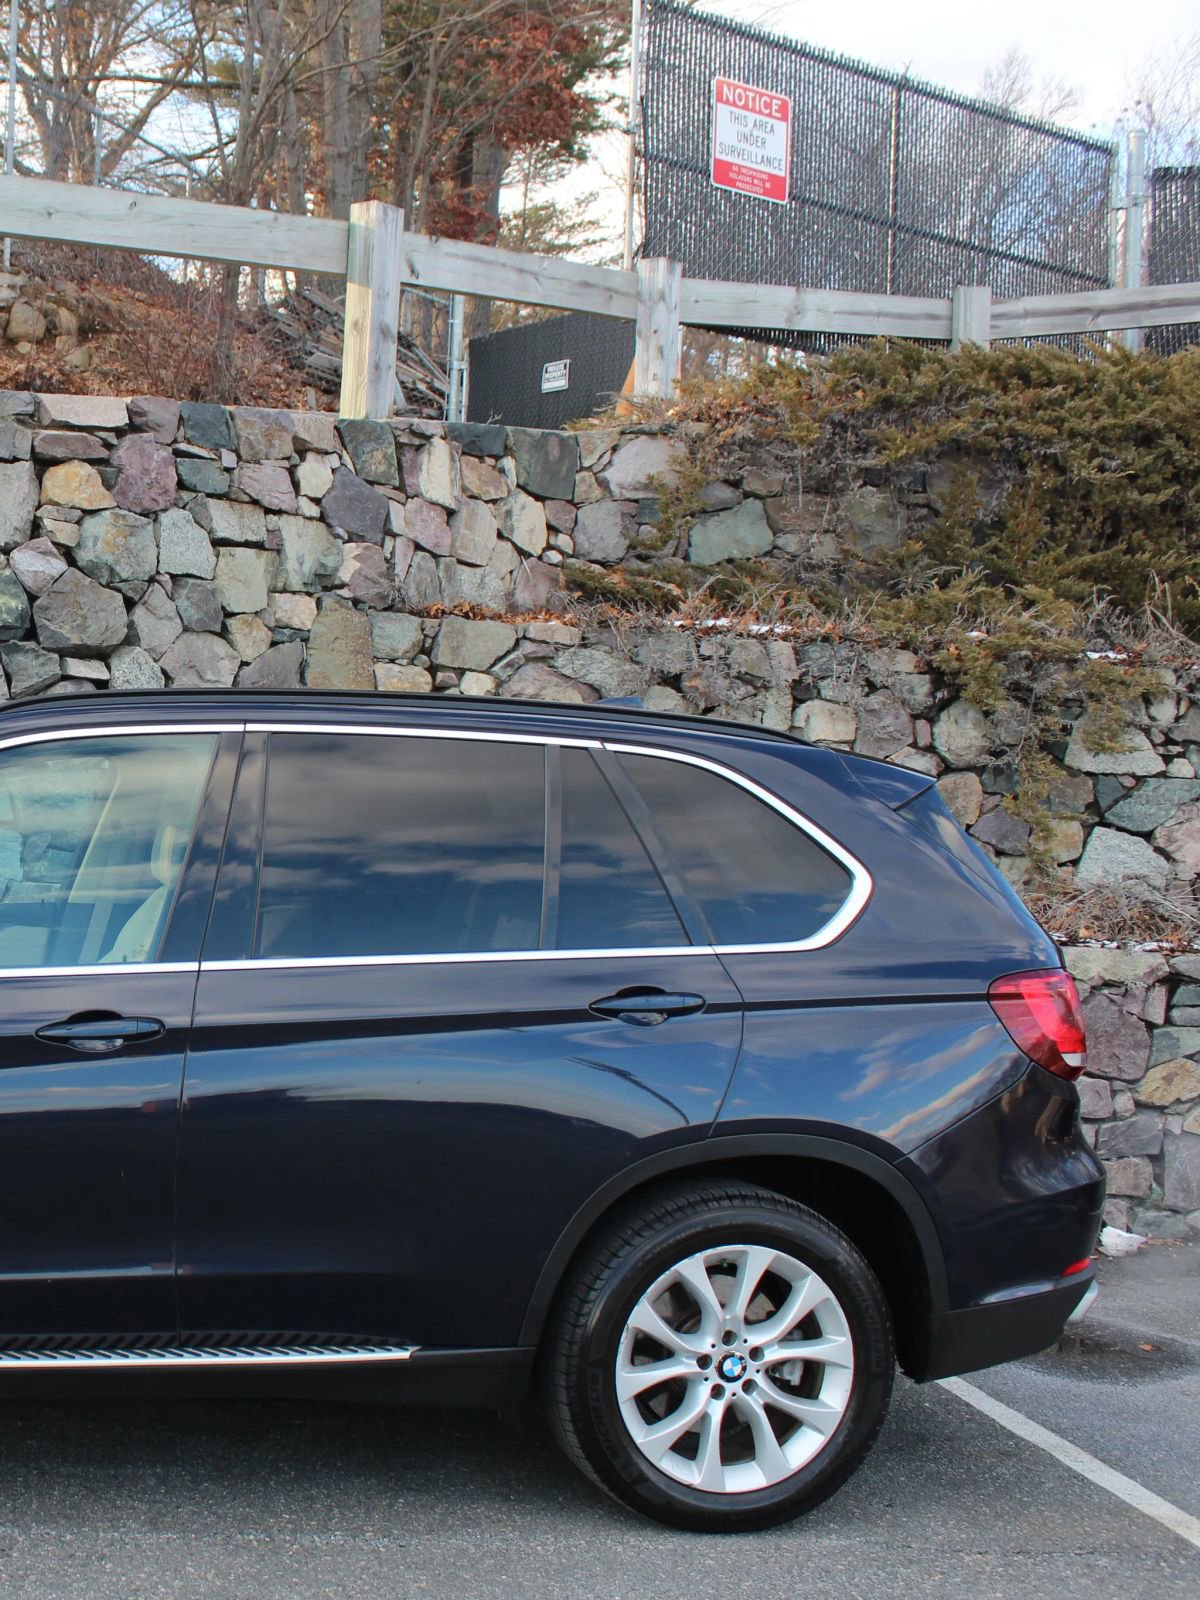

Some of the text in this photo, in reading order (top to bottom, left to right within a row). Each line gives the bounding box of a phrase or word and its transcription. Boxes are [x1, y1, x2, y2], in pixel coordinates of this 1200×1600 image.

[722, 83, 782, 118] NOTICE
[729, 110, 775, 136] THIS AREA
[736, 130, 767, 150] UNDER
[718, 142, 784, 172] SURVEILLANCE
